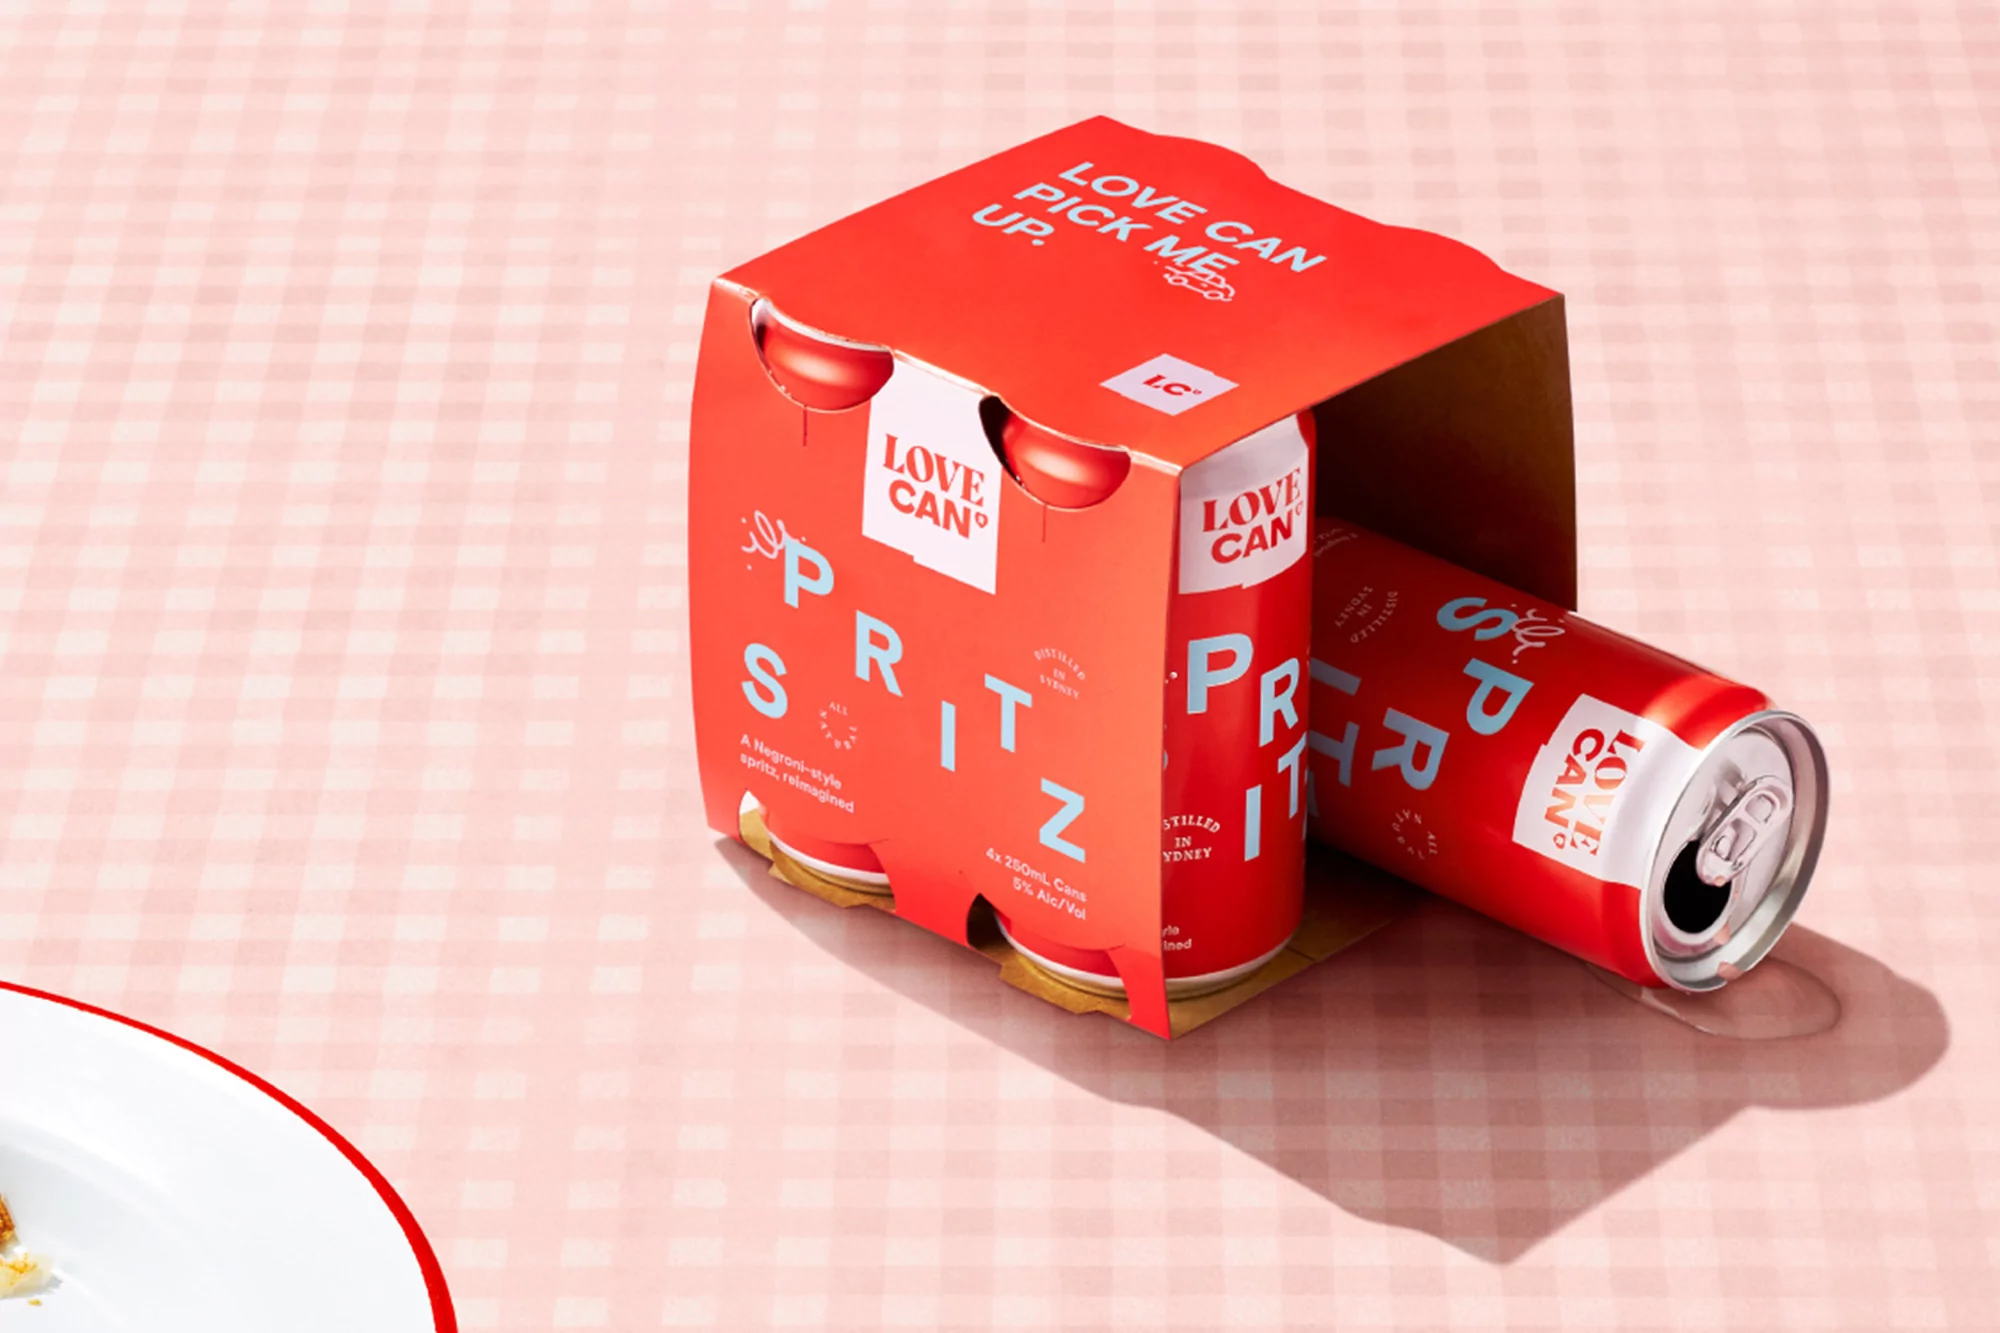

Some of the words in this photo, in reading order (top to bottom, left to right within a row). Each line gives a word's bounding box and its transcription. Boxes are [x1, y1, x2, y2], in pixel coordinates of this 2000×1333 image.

[972, 204, 1055, 246] UP.
[1013, 183, 1153, 242] PICK
[1143, 235, 1240, 275] ME
[1058, 162, 1208, 224] LOVE
[1205, 221, 1327, 272] CAN
[883, 433, 985, 507] LOVE
[1203, 467, 1301, 532] LOVE
[1034, 648, 1086, 681] DISTILLED
[1053, 668, 1066, 681] IN
[829, 701, 848, 716] ALL
[1040, 674, 1079, 700] SYDNEY
[740, 734, 751, 748] A
[754, 738, 842, 790] Negroni-style
[740, 753, 780, 781] spritz,
[783, 773, 855, 813] reimagined
[1570, 729, 1646, 856] LOVE
[1163, 814, 1221, 833] STILLED
[1175, 835, 1192, 848] IN
[986, 847, 1002, 864] 4x
[1004, 855, 1051, 887] 250mL
[1053, 877, 1087, 903] Cans
[1162, 846, 1212, 863] YDNEY
[1013, 876, 1034, 896] 5%
[1036, 889, 1087, 920] Alc/Vol
